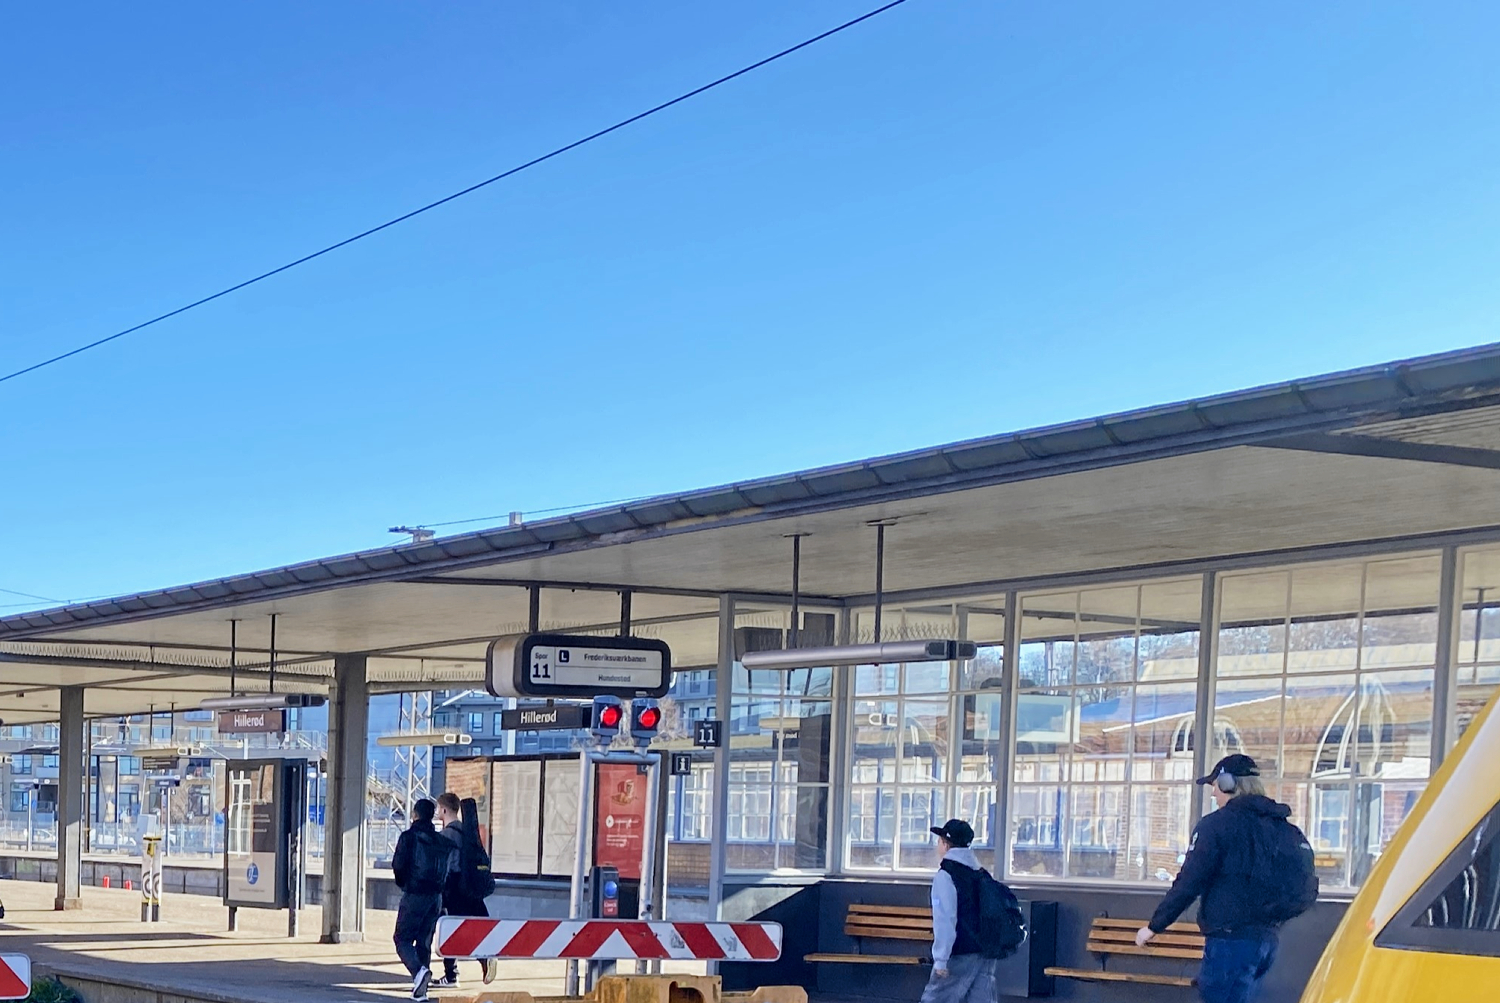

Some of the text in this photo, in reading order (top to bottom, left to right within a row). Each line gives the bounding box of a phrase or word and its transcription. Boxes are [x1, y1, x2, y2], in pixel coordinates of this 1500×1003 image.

[535, 652, 548, 660] Spor
[532, 663, 551, 679] 11
[234, 713, 265, 727] Hillerød
[520, 709, 557, 724] Hillerød
[698, 728, 716, 743] 11
